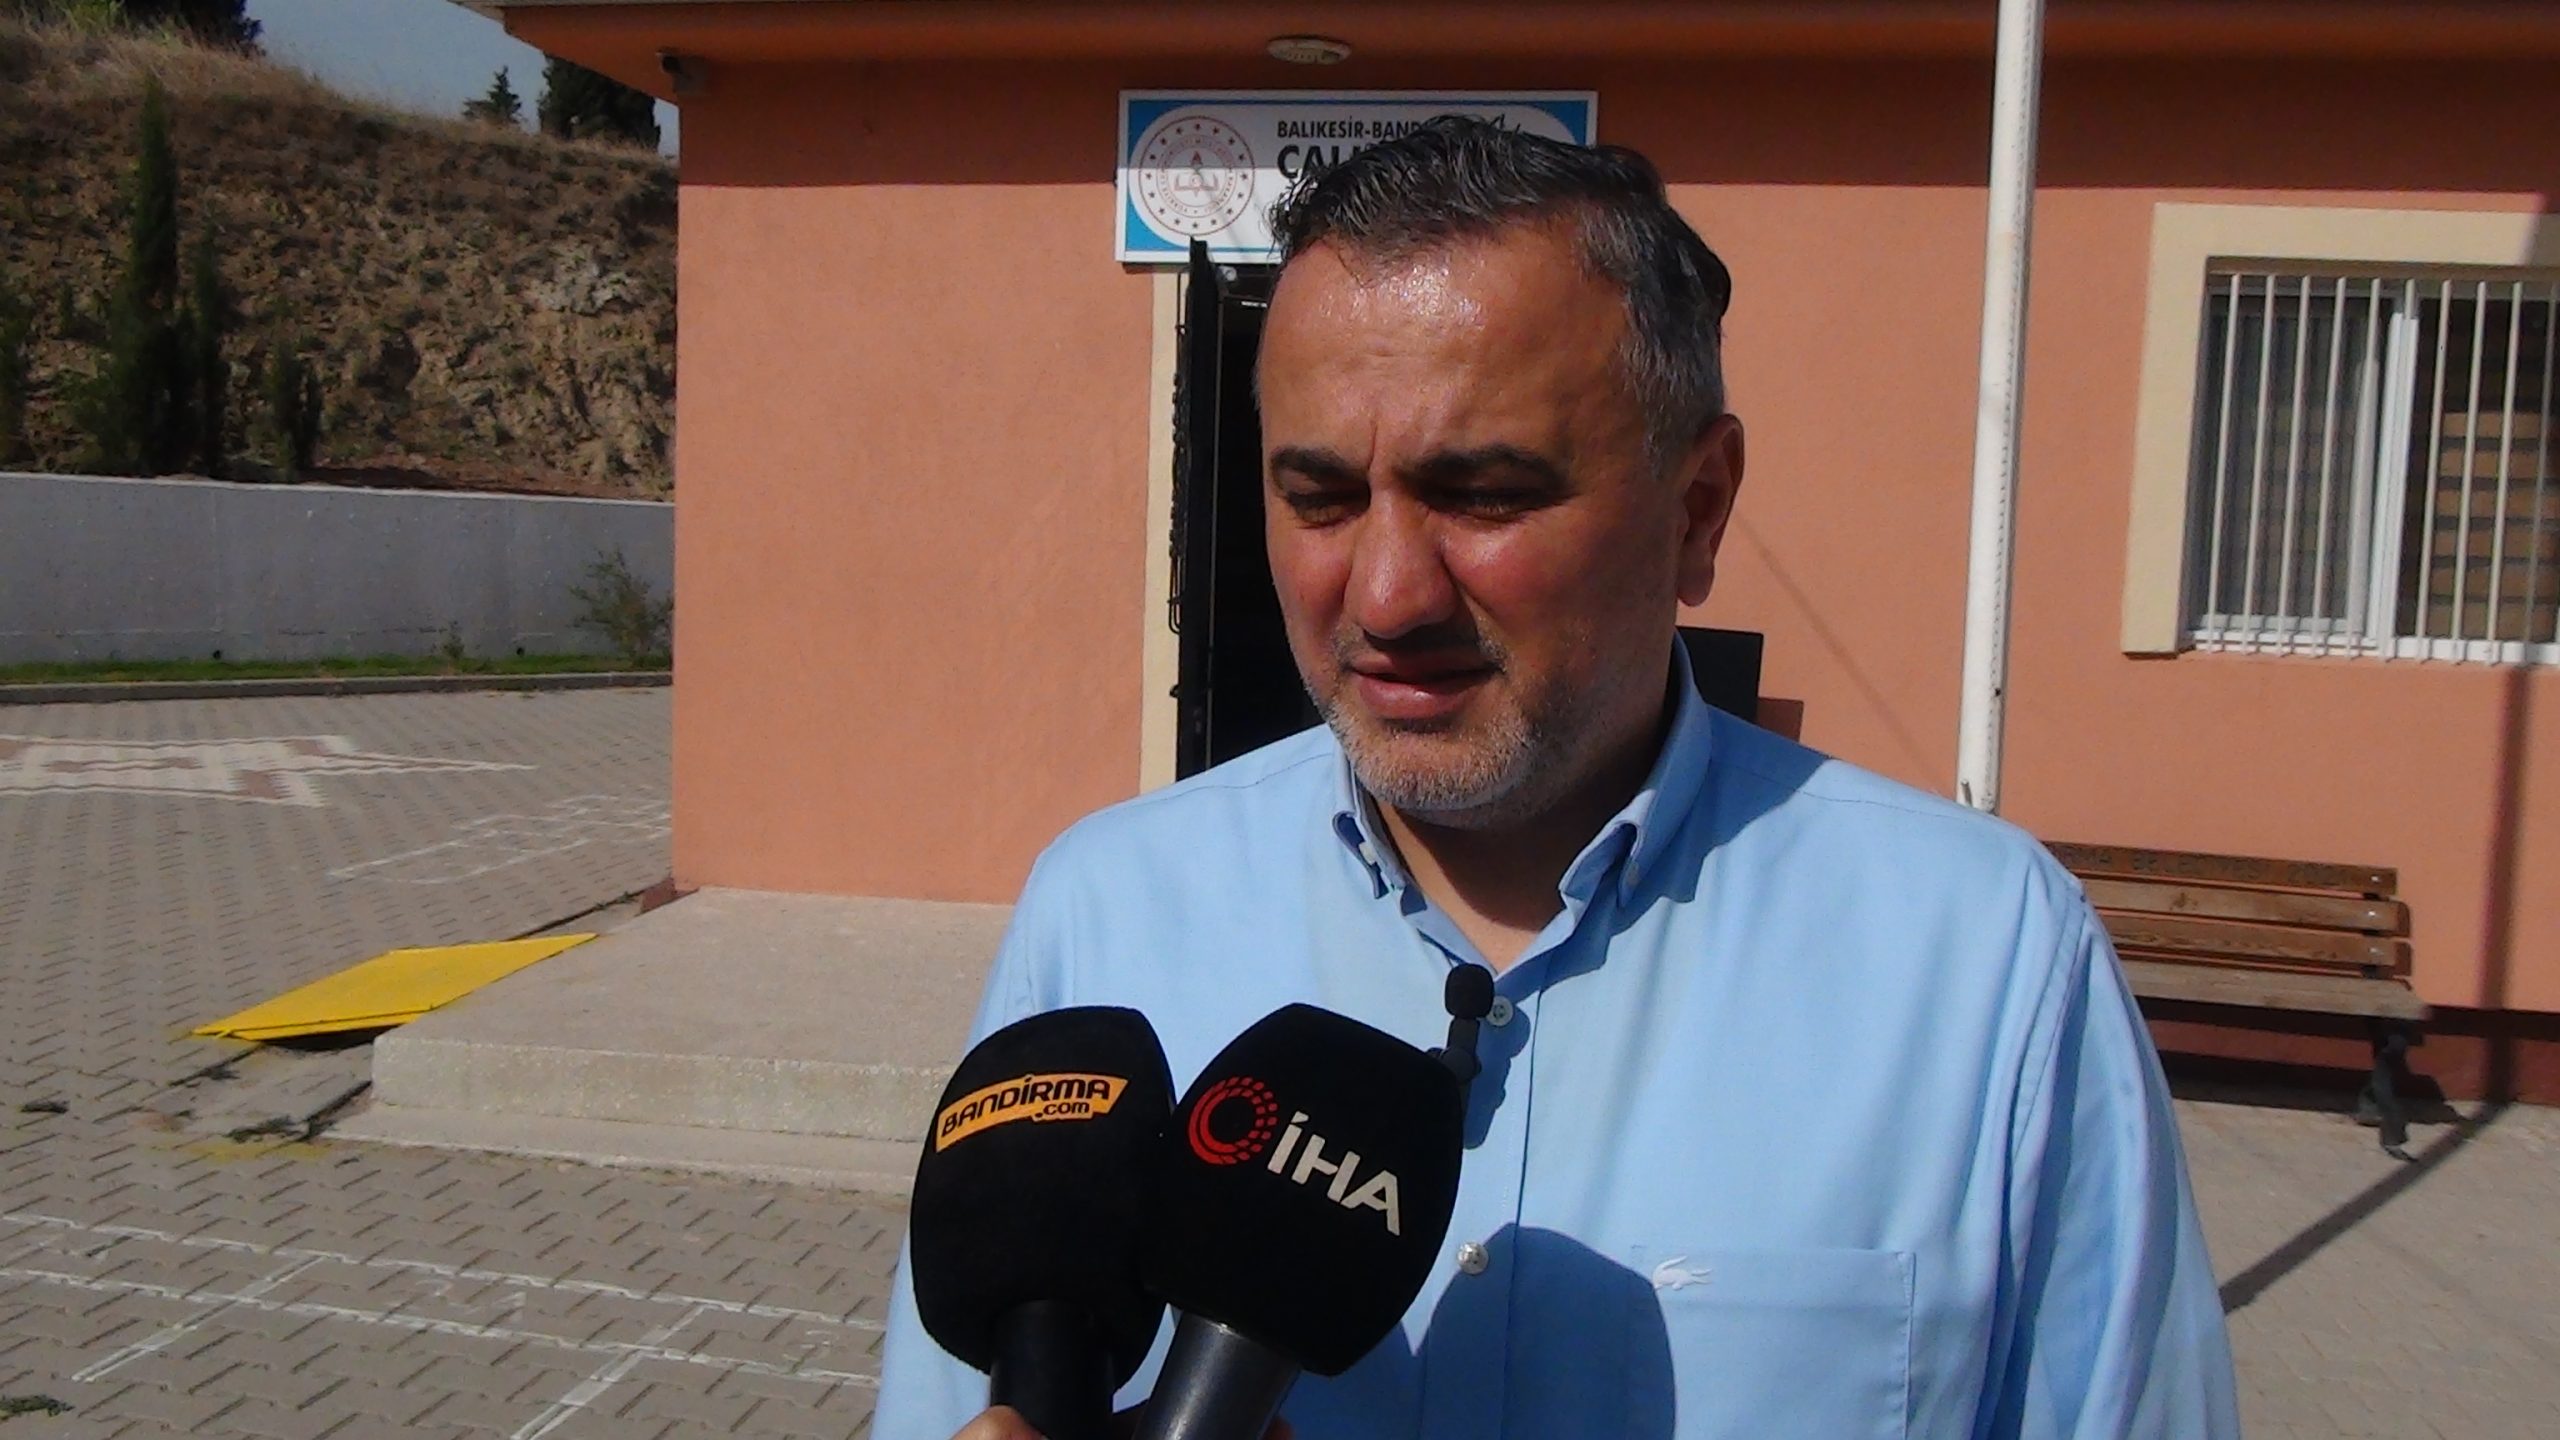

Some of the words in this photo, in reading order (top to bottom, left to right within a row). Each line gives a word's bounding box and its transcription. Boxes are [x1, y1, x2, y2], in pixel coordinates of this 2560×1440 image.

[1277, 115, 1423, 139] BALIKESİR-BAND
[1035, 1102, 1091, 1118] .com
[1267, 1110, 1400, 1236] İHA
